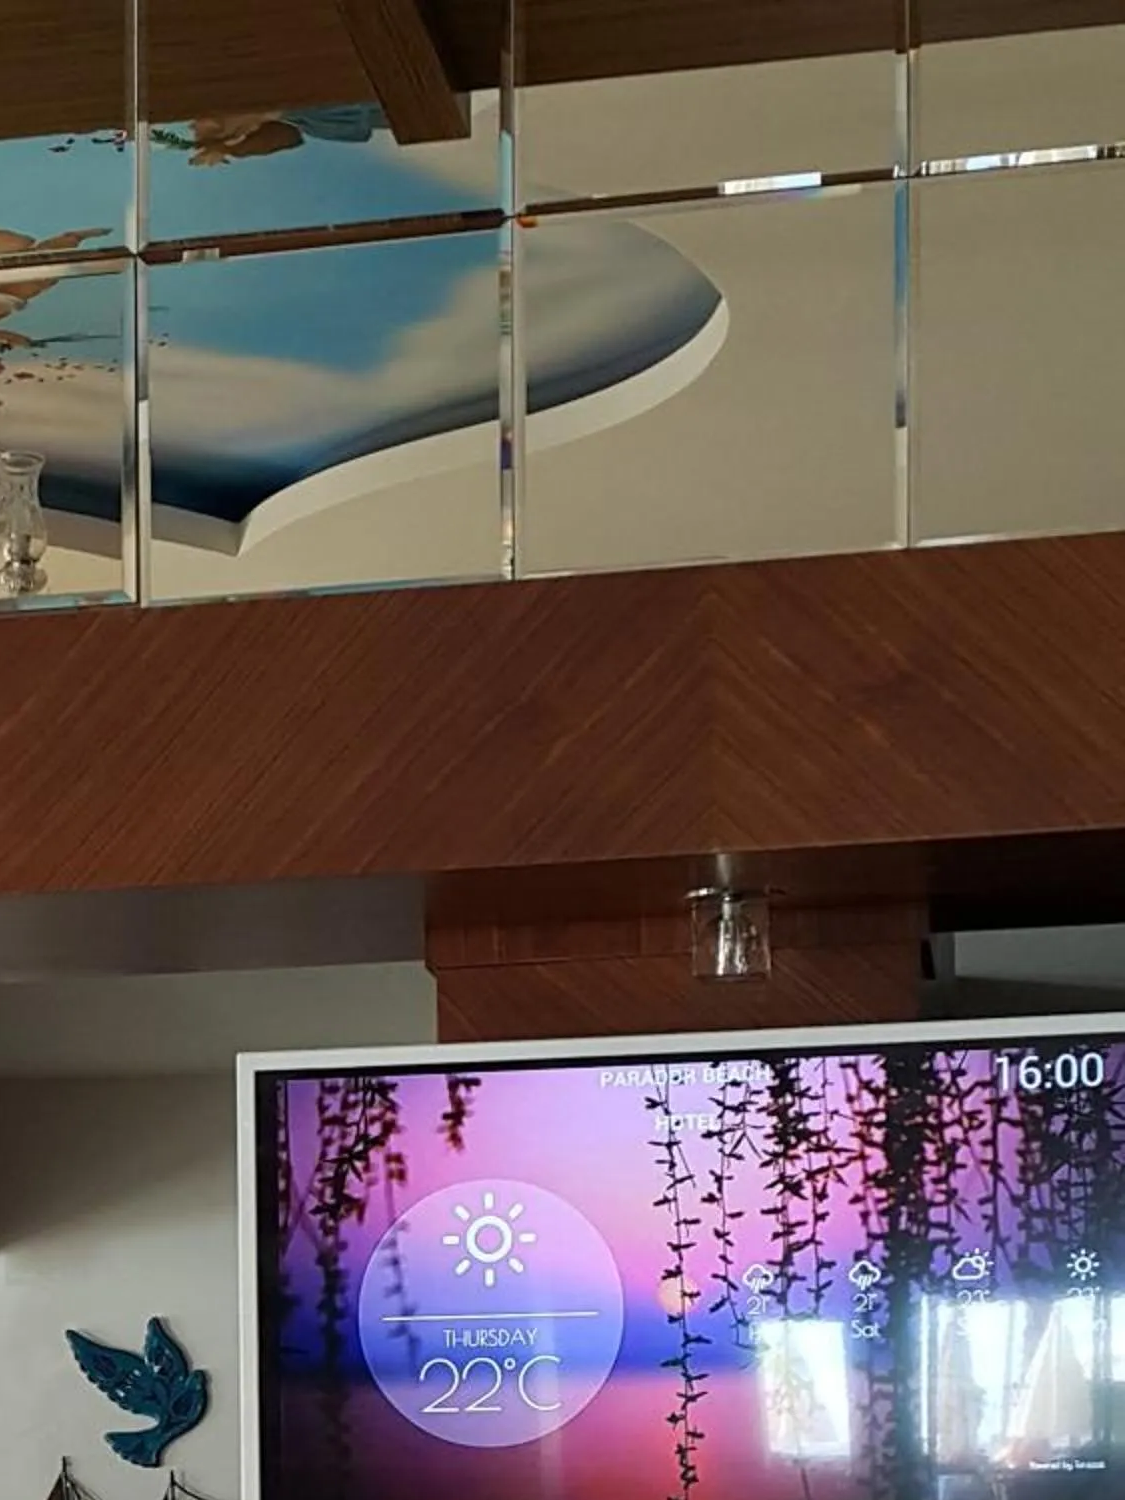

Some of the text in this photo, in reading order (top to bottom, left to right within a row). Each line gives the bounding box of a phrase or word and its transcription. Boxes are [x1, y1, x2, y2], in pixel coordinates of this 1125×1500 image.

[600, 1064, 771, 1088] PARADOR BEACH
[995, 1052, 1104, 1091] 16:00
[655, 1113, 722, 1132] HOTEL
[443, 1328, 538, 1349] THURSDAY
[851, 1319, 881, 1340] Sat
[419, 1354, 562, 1413] 22°C
